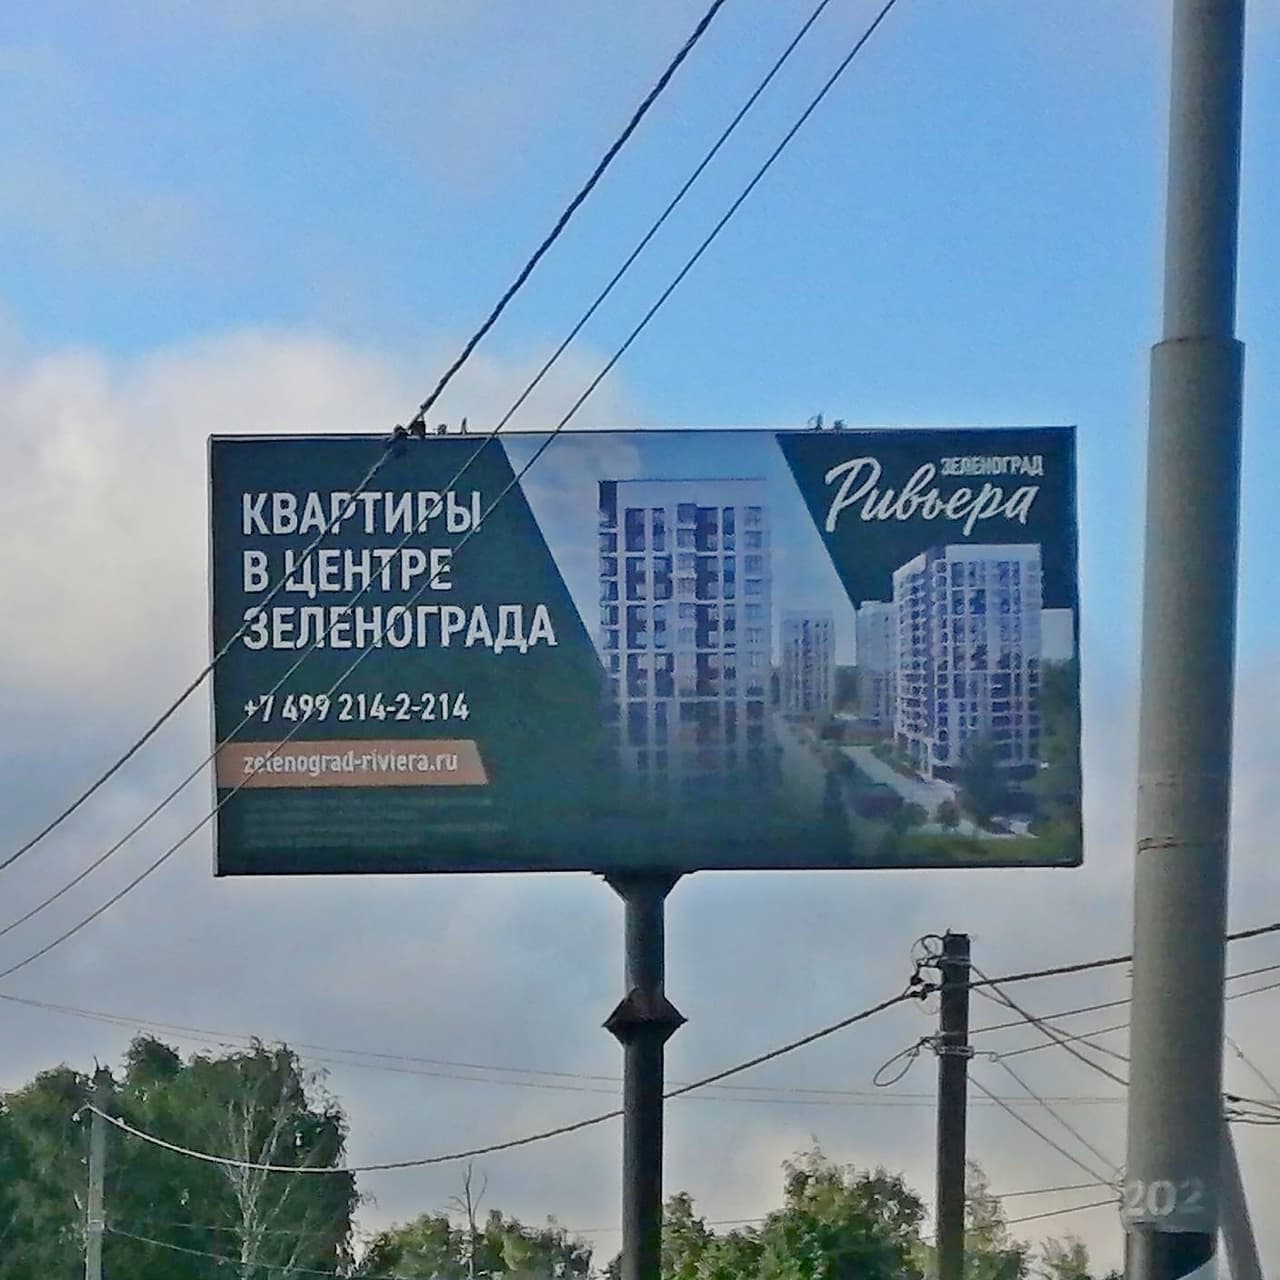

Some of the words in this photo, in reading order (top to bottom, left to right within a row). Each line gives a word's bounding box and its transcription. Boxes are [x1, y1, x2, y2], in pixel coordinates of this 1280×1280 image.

[242, 490, 482, 535] КВАРТИРЫ
[824, 456, 1040, 537] Ривьера
[242, 549, 269, 593] В
[285, 548, 453, 599] ЦЕНТРЕ
[242, 604, 558, 654] ЗЕЛЕНОГРАДА
[244, 695, 274, 722] +7
[281, 694, 331, 722] 499
[338, 691, 471, 722] 214-2-214
[243, 750, 458, 777] zelenograd-riviera.ru
[1122, 1178, 1205, 1217] 202
